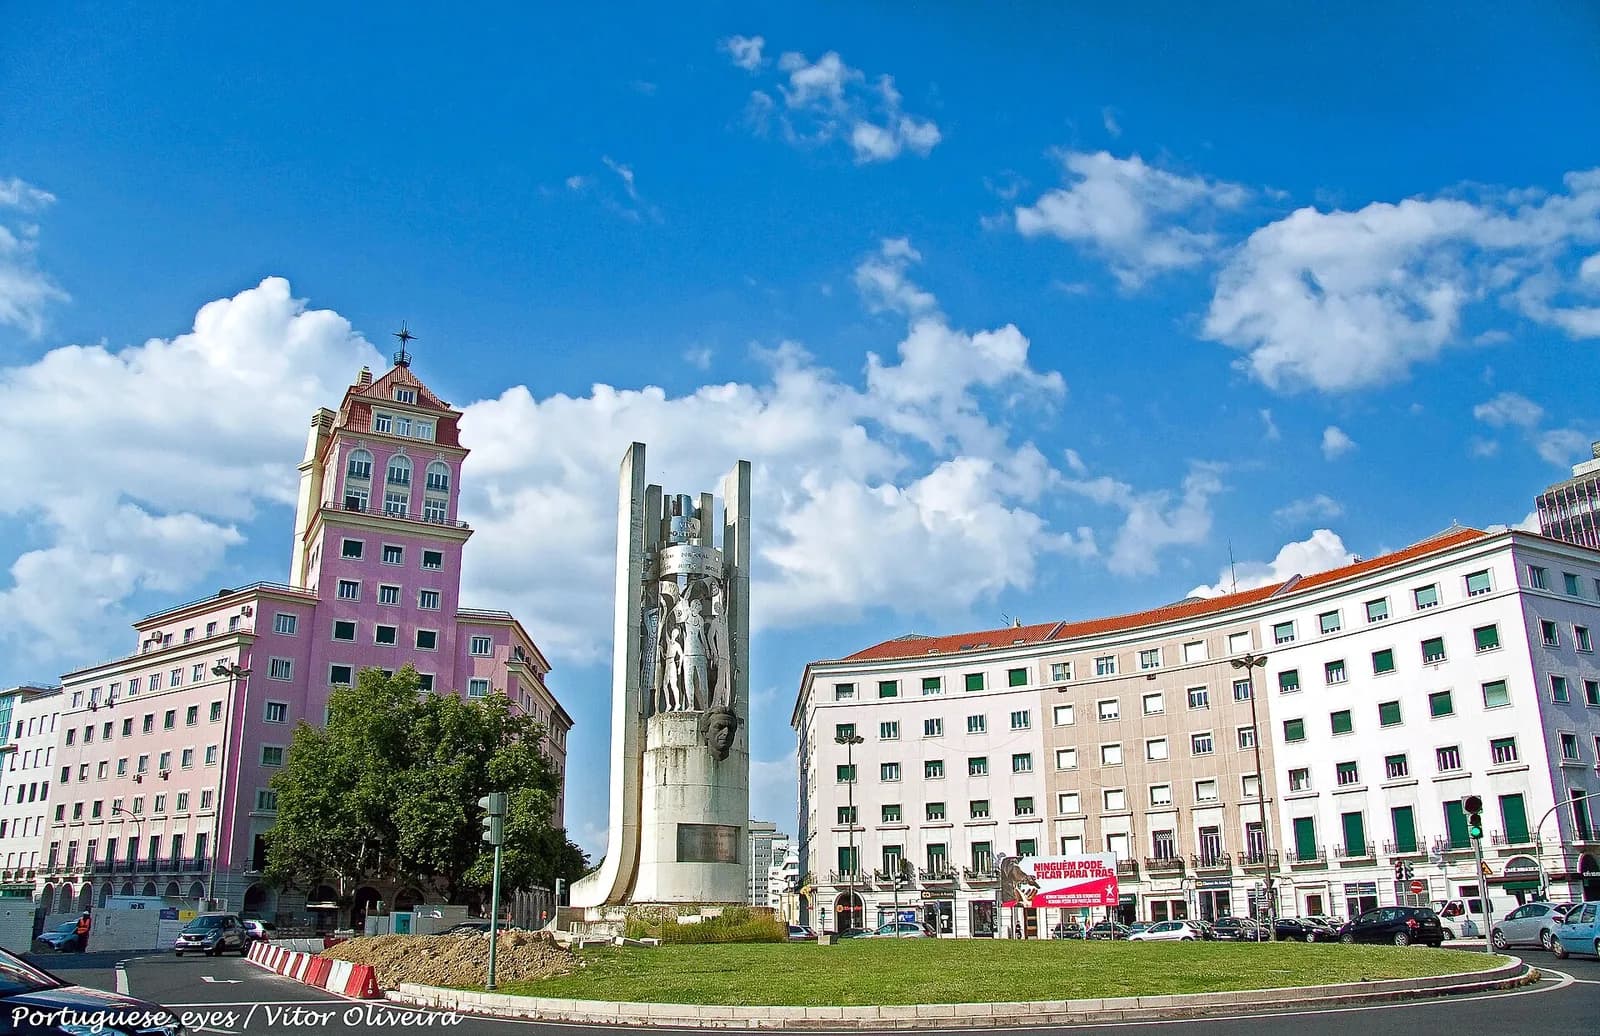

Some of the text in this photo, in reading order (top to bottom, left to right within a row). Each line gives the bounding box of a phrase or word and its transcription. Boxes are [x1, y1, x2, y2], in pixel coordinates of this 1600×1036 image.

[1033, 859, 1103, 872] NINGUÉM PODE
[1036, 871, 1062, 880] FICAR
[1063, 869, 1088, 879] PARA
